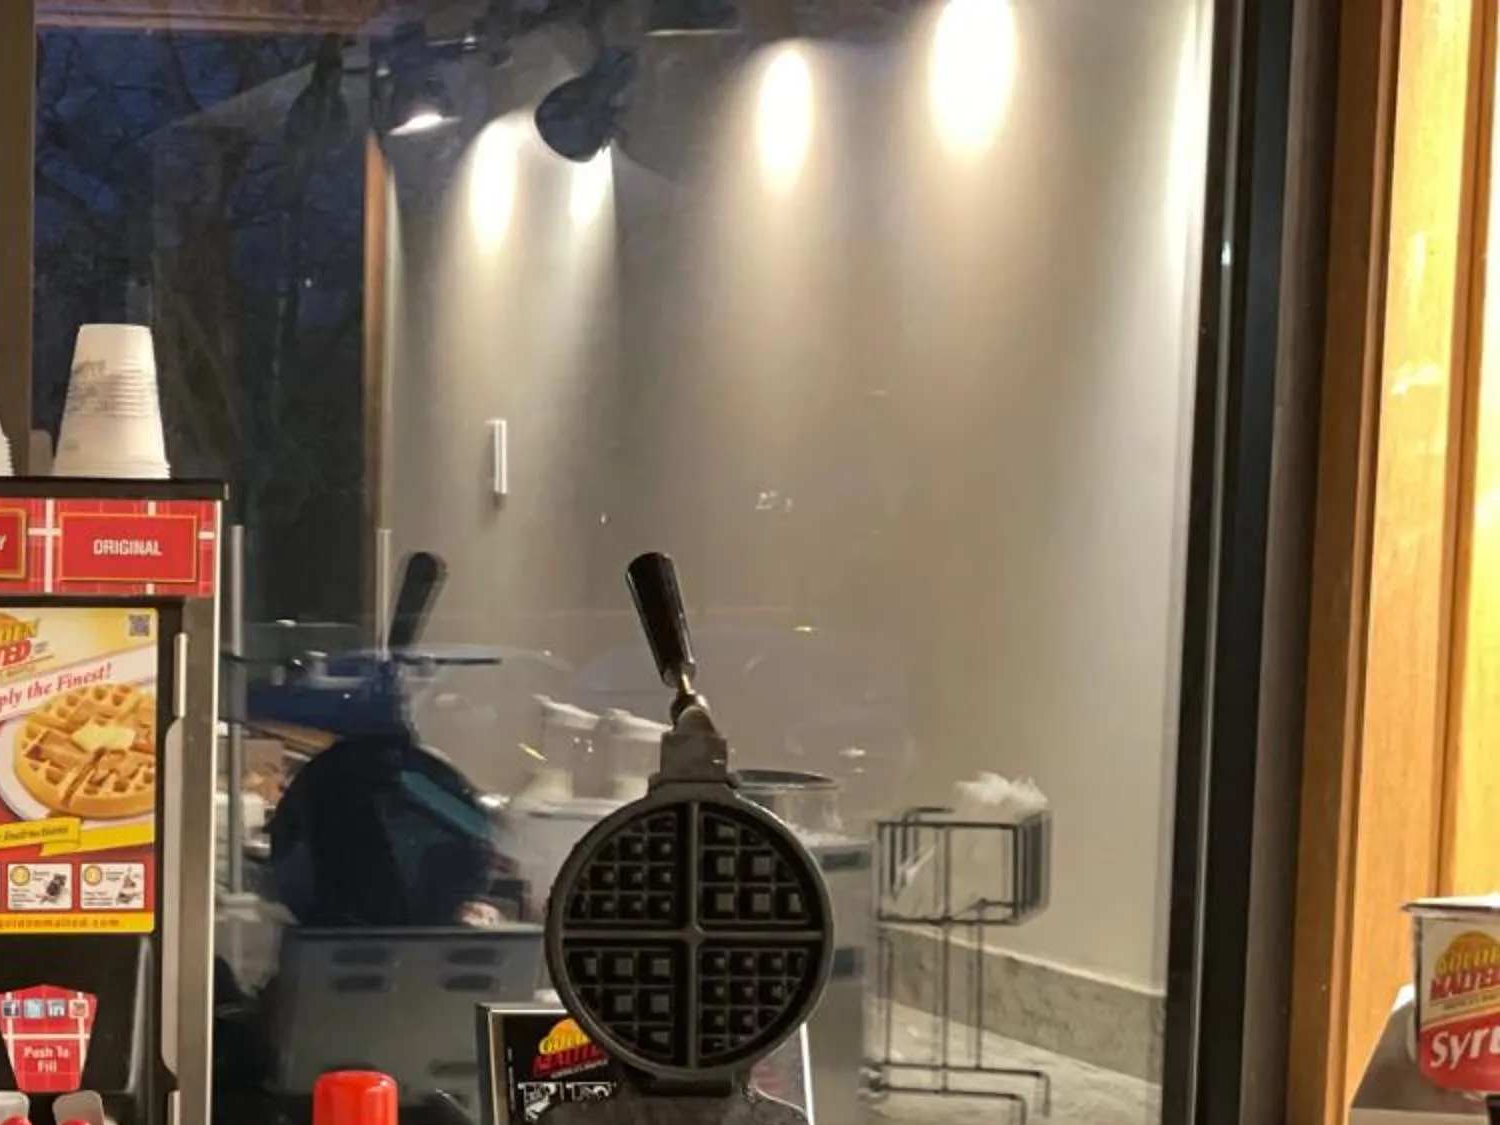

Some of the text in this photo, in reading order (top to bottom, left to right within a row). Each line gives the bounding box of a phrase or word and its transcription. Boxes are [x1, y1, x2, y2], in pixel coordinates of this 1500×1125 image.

[93, 538, 162, 557] ORIGINAL
[27, 681, 52, 698] the
[56, 663, 112, 691] Finest!
[23, 1046, 70, 1059] Push To
[37, 1060, 58, 1073] Fill
